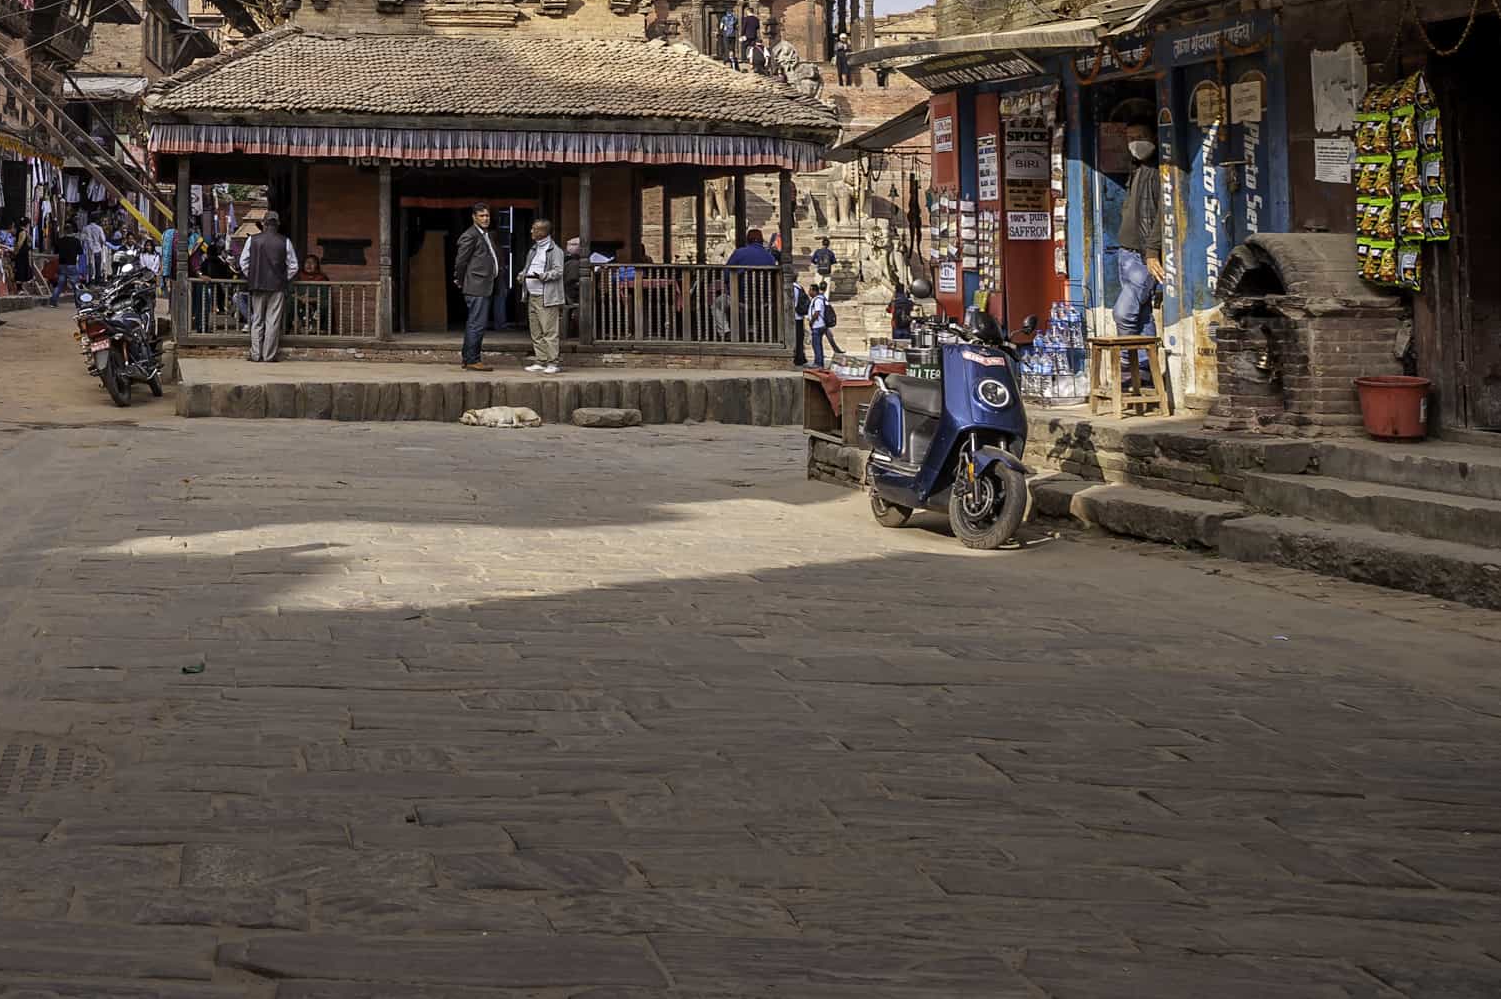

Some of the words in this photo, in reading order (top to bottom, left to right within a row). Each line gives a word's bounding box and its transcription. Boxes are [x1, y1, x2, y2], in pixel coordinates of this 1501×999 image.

[1006, 131, 1049, 142] SPICE
[1242, 120, 1260, 190] Photo
[1015, 159, 1040, 169] BIRI
[1029, 213, 1048, 224] pure
[1009, 226, 1048, 238] SAFFRON
[1203, 195, 1222, 296] Service
